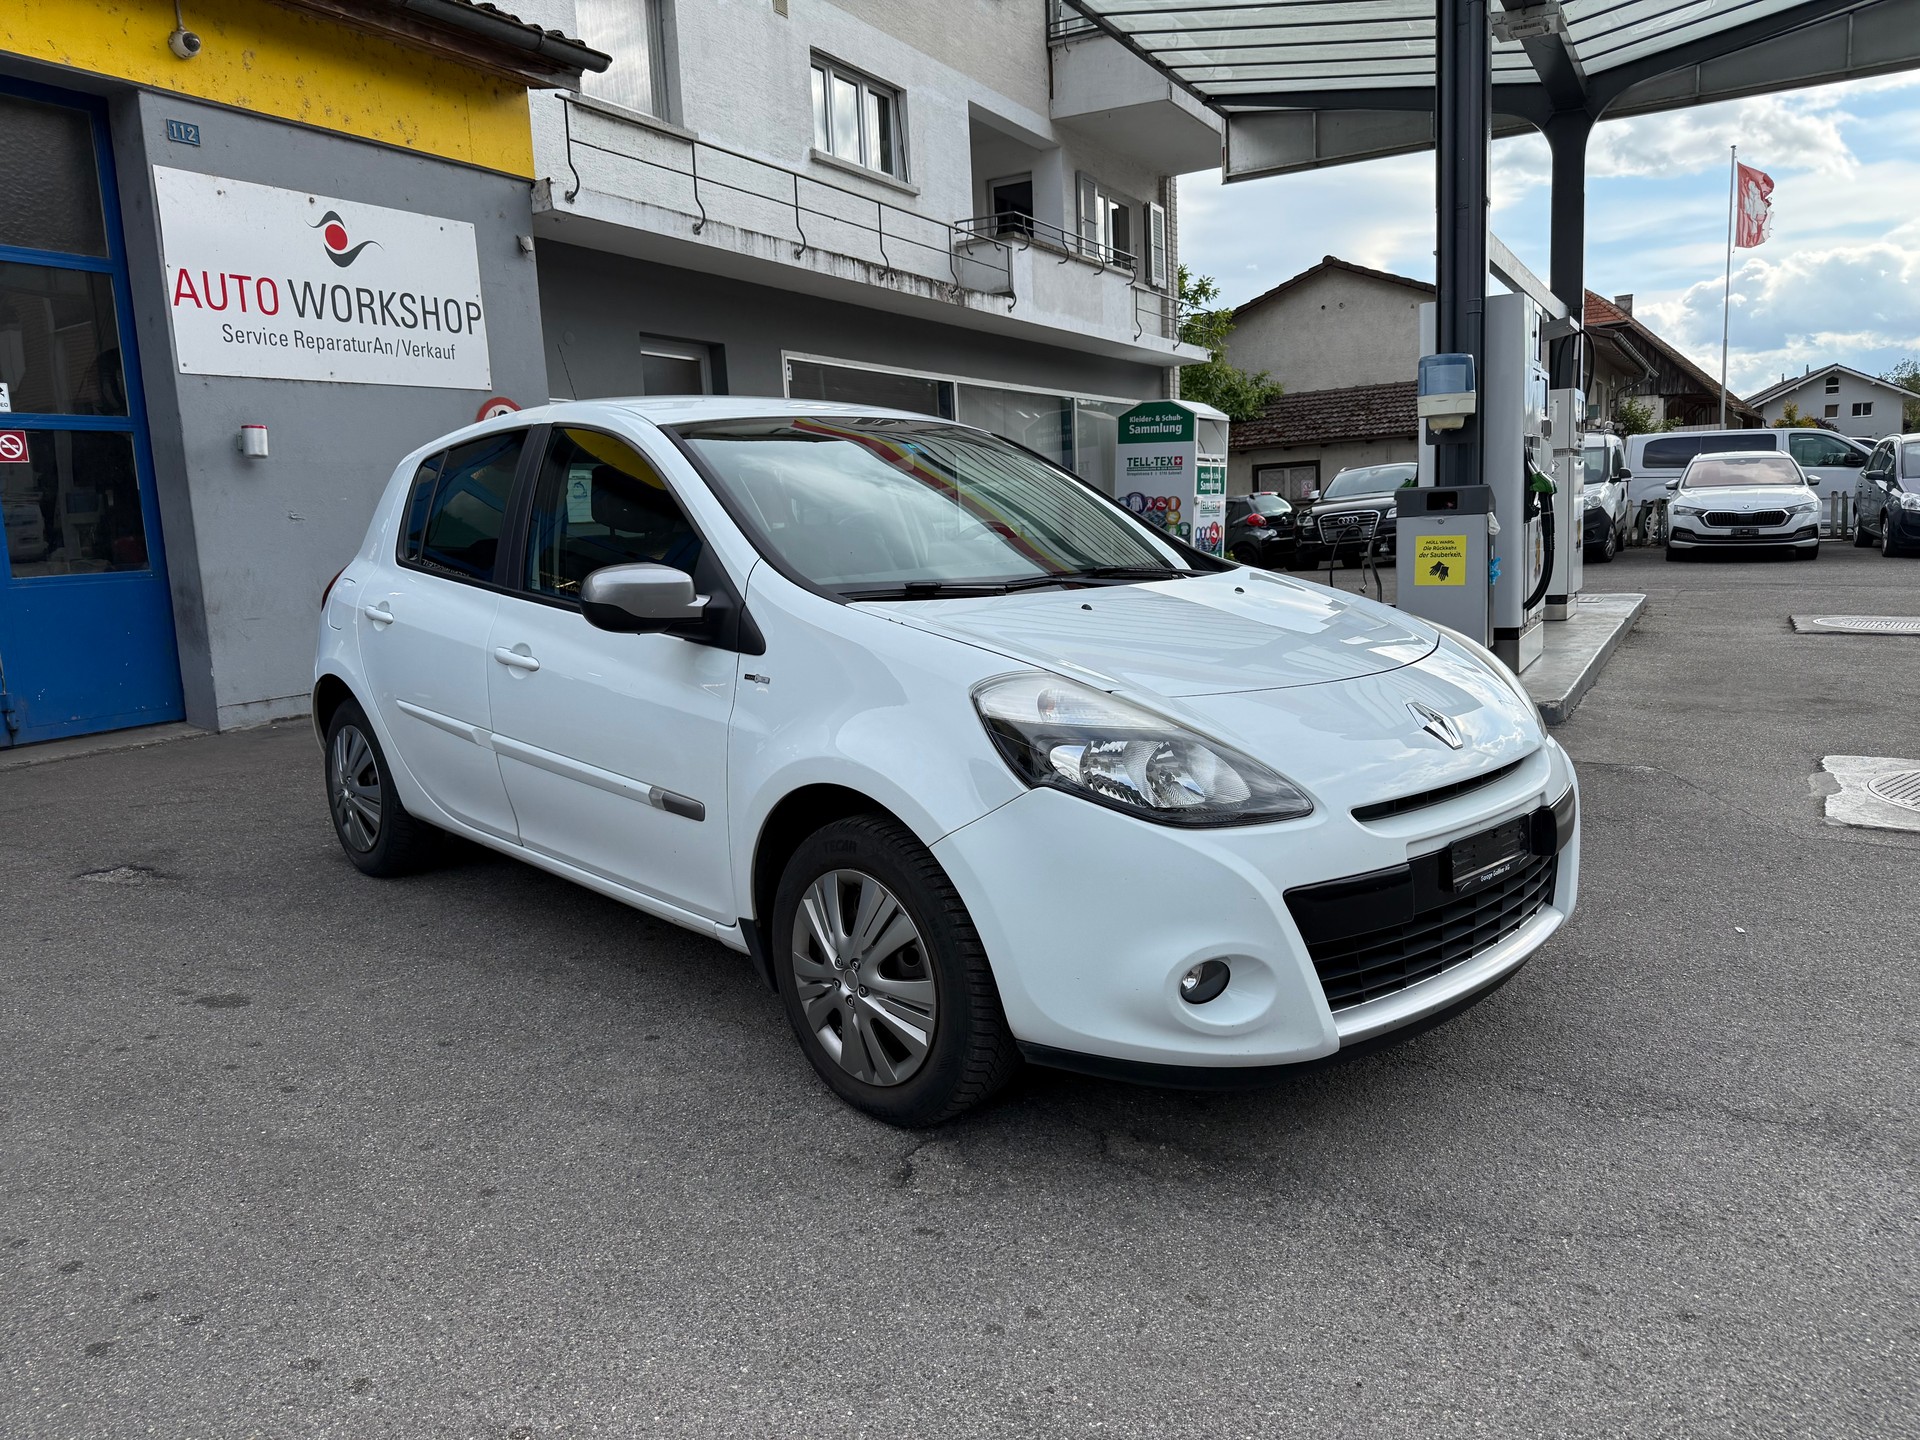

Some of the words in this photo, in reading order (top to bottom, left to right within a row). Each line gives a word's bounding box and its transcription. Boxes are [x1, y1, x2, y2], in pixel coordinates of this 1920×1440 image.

[171, 122, 196, 141] 112
[174, 268, 279, 316] AUTO
[287, 278, 482, 335] WORKSHOP
[222, 323, 288, 347] Service
[294, 329, 456, 360] ReparaturAn/Verkauf
[1129, 415, 1154, 423] Kleider-
[1161, 413, 1183, 422] Schuh-
[1129, 422, 1182, 435] Sammlung
[1127, 456, 1173, 467] TELL-TEX
